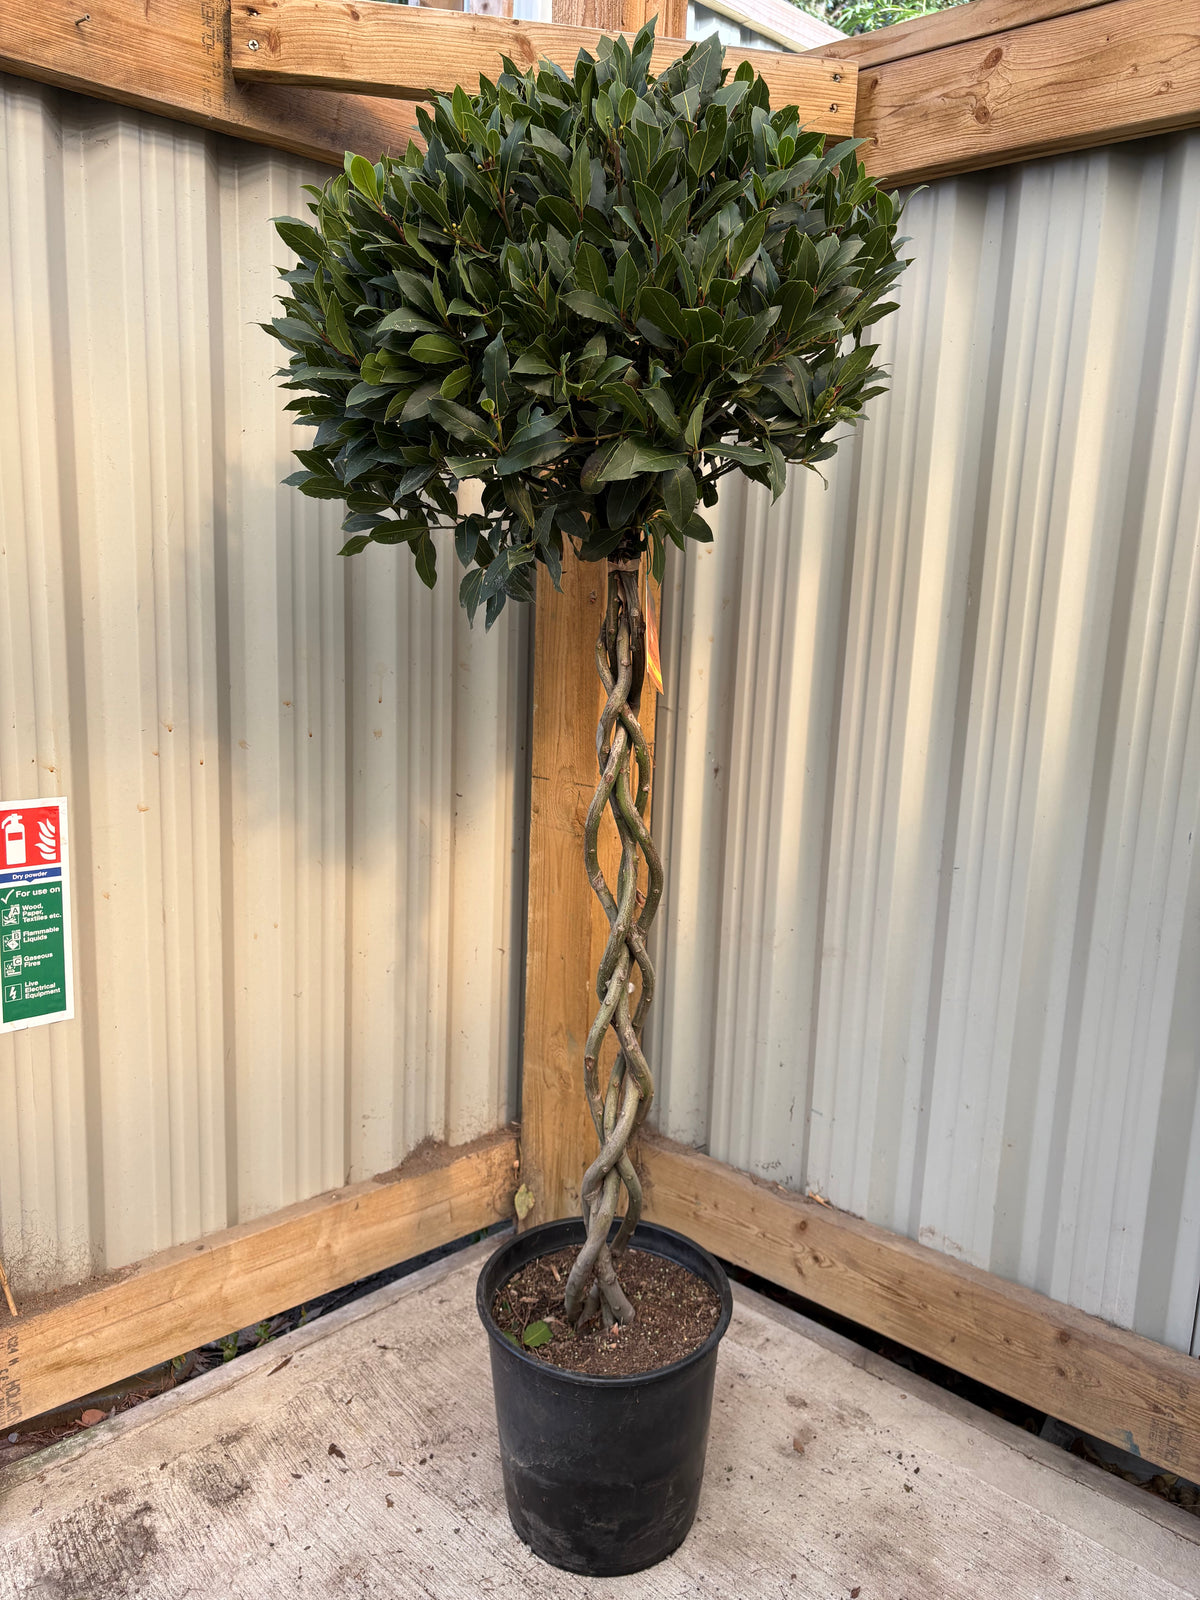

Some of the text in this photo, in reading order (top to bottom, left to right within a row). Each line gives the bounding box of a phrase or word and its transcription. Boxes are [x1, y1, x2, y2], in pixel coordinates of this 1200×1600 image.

[25, 871, 48, 879] powder
[15, 890, 30, 898] For
[23, 915, 48, 923] Textiles
[23, 927, 59, 937] Flammable
[23, 934, 48, 943] Liquids
[24, 952, 53, 962] Gaseous
[24, 960, 41, 968] Fires
[25, 982, 56, 993] Electrical
[25, 988, 61, 999] Equipment
